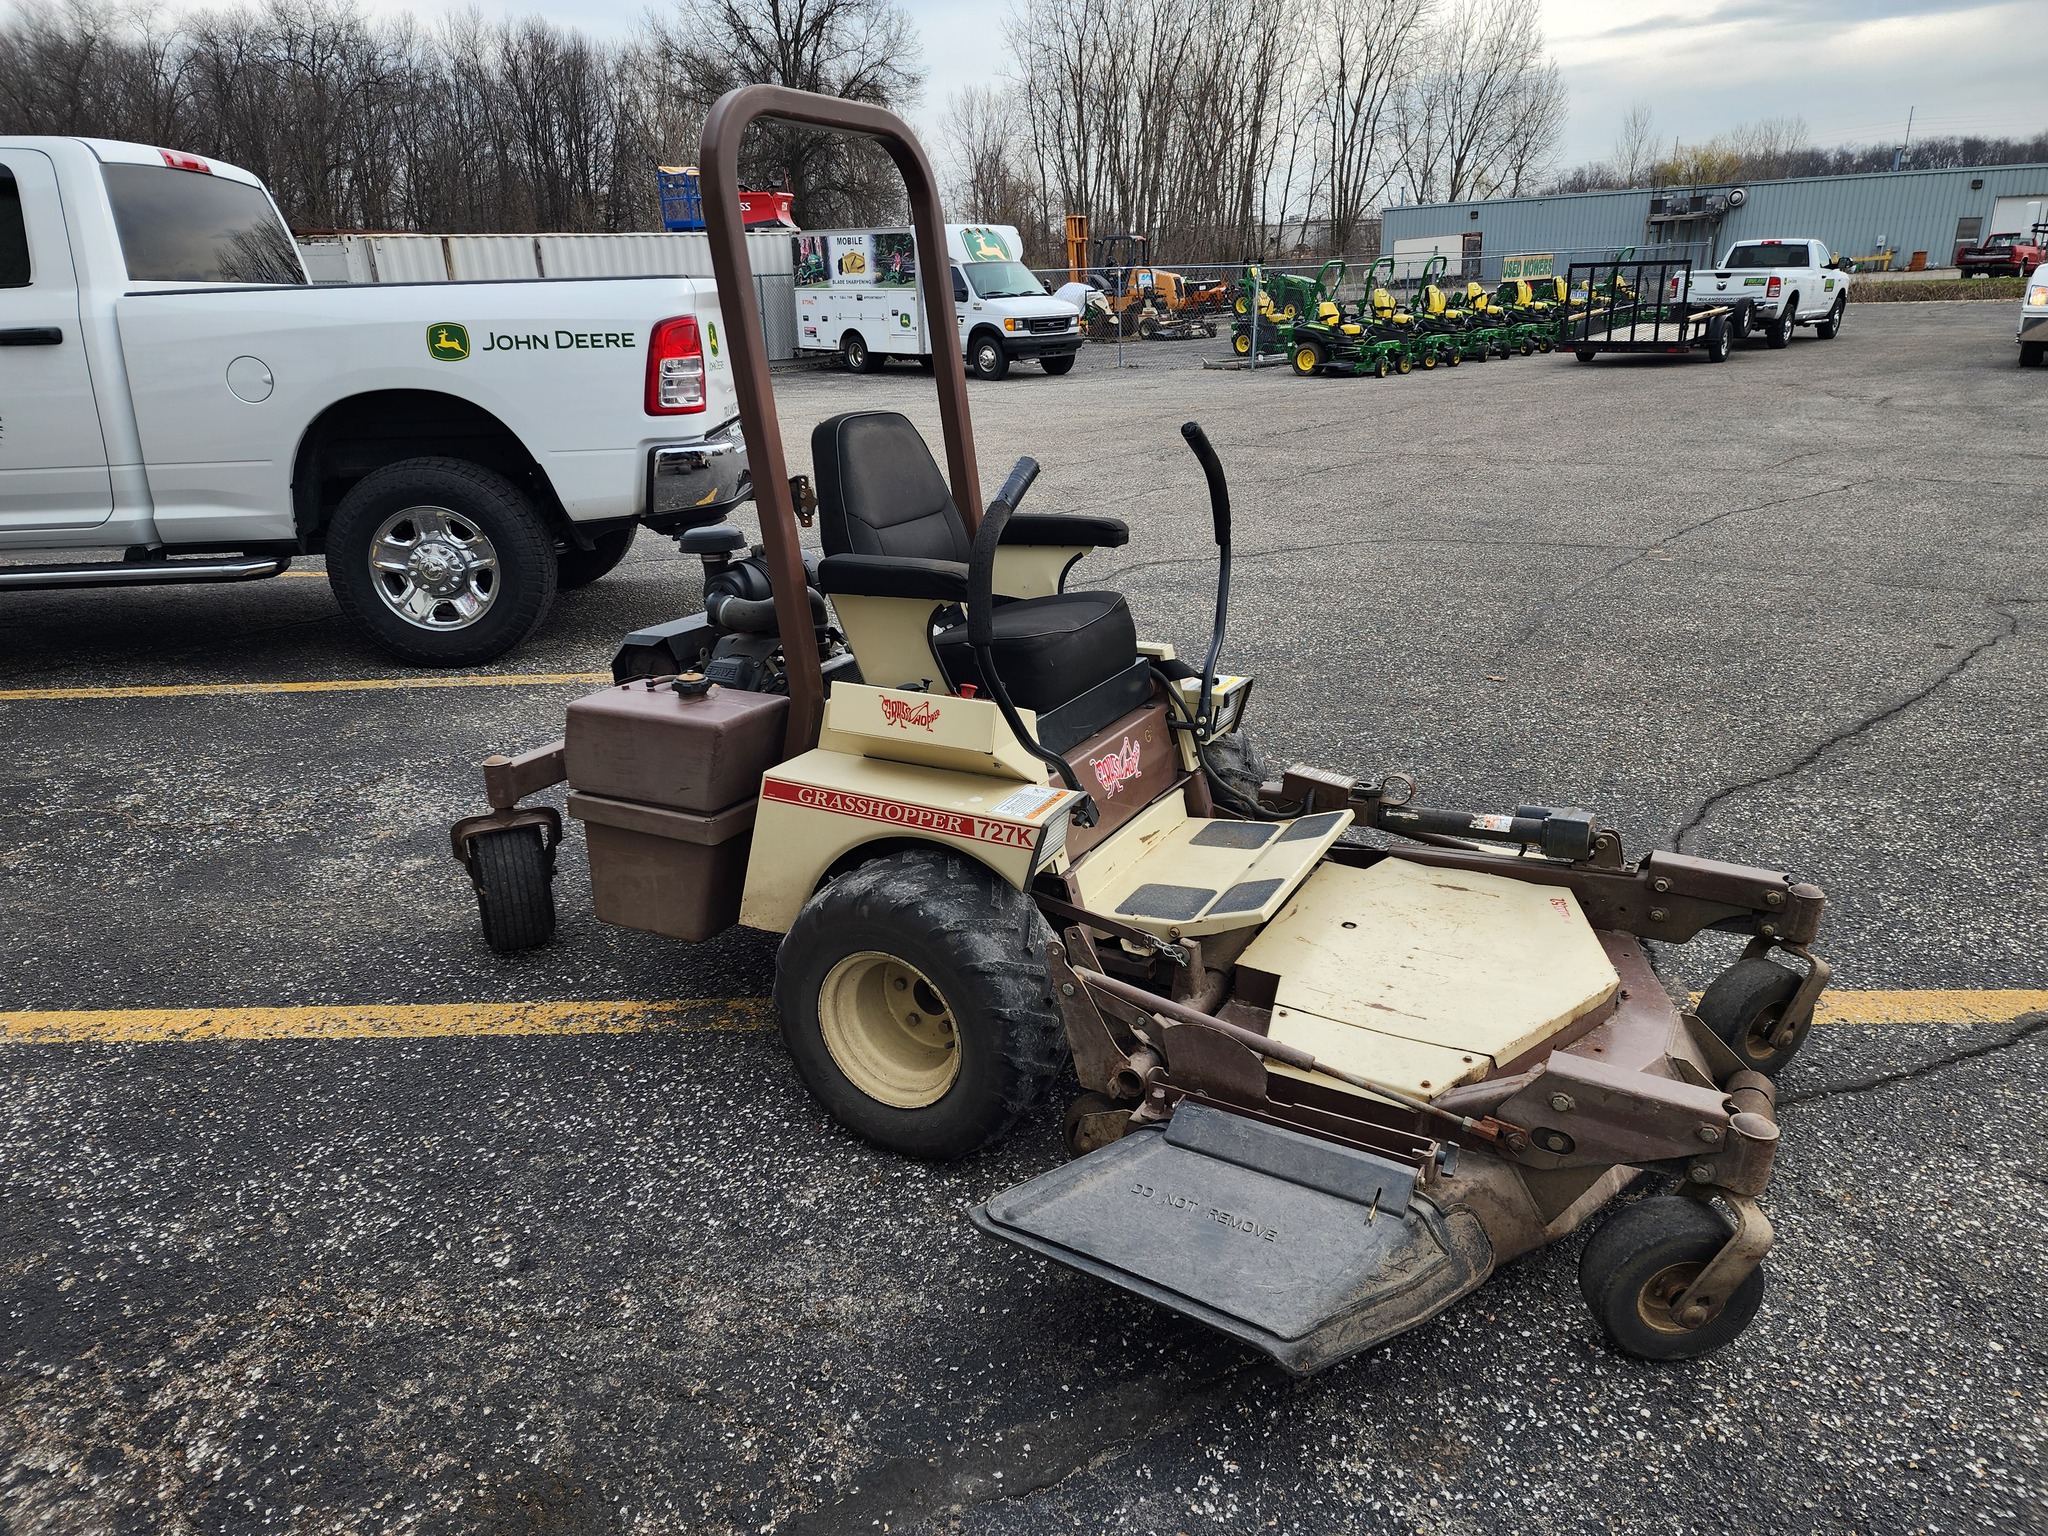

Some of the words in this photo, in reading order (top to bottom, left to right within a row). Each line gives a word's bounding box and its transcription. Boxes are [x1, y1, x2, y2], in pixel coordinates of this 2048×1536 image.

[740, 202, 751, 211] SS
[836, 236, 863, 246] MOBILE
[1503, 260, 1522, 278] USED
[1522, 258, 1553, 277] MOWERS
[482, 331, 550, 351] JOHN
[554, 330, 636, 349] DEERE
[797, 787, 963, 833] GRASSHOPPER
[976, 819, 1034, 848] 727K
[1130, 1183, 1156, 1198] DO
[1163, 1193, 1198, 1213] NOT
[1206, 1208, 1278, 1243] REMOVE
